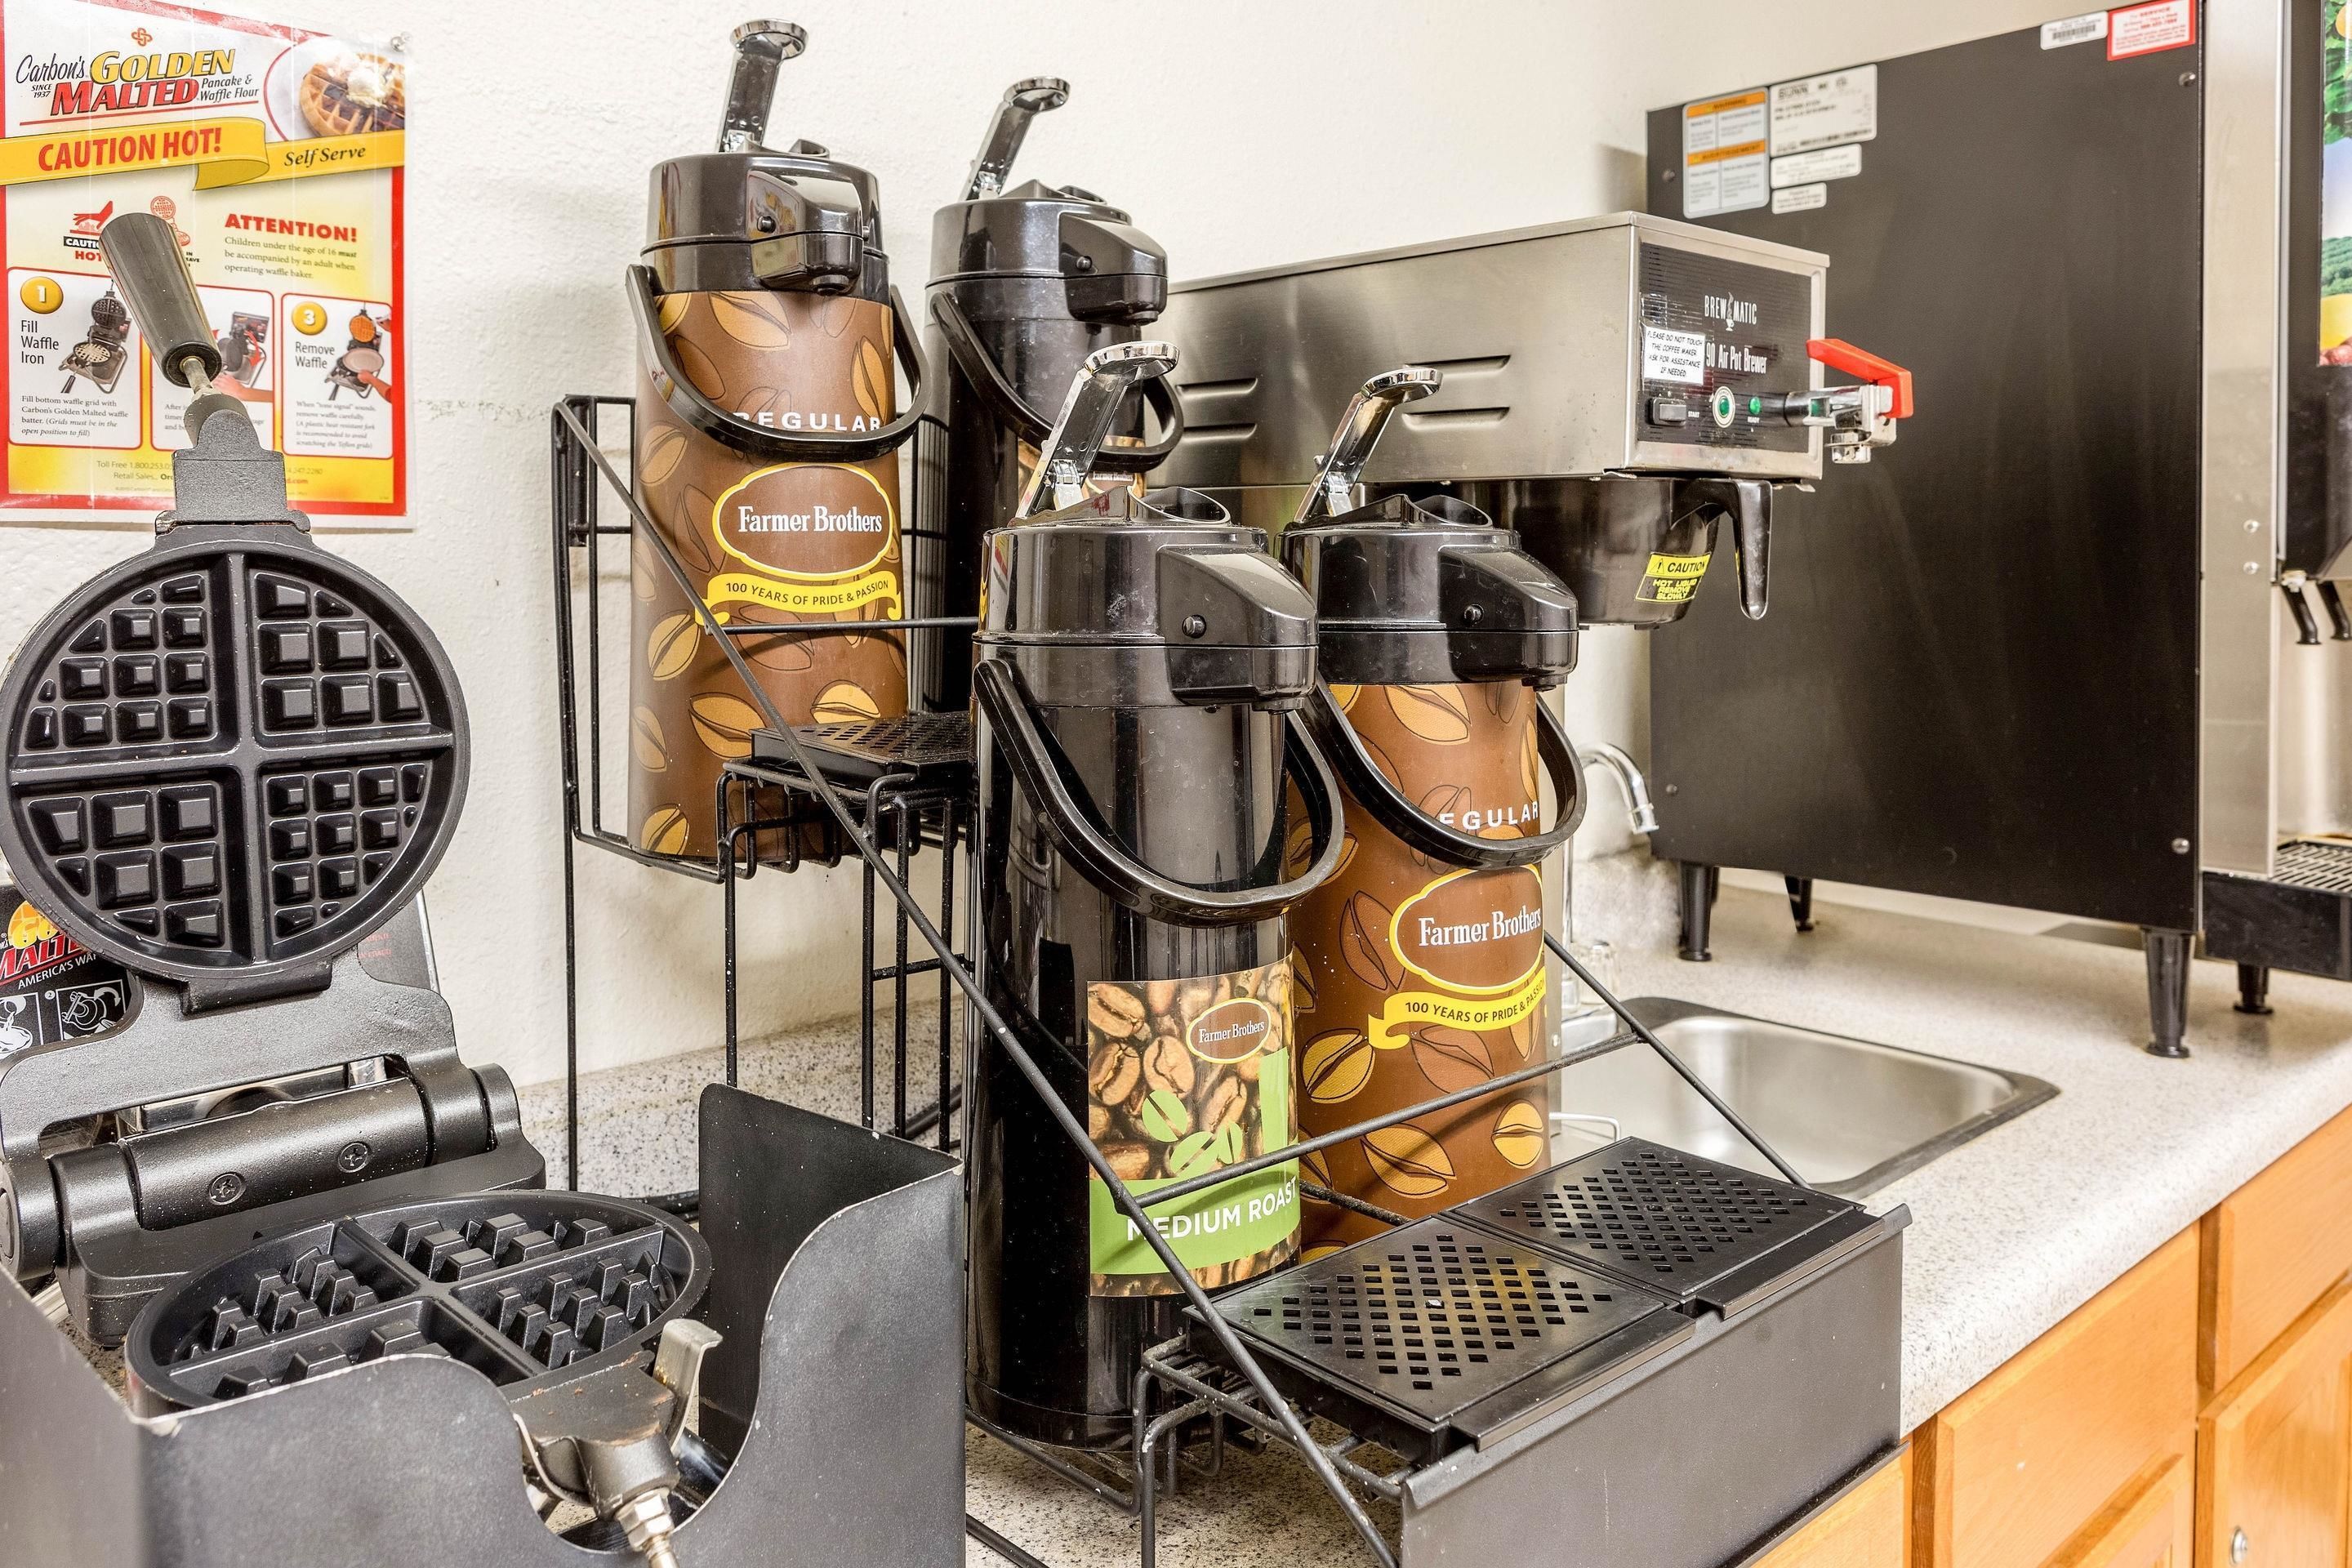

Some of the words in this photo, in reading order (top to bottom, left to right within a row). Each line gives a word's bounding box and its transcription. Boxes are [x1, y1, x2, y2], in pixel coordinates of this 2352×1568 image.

[16, 53, 85, 83] Carbon's
[90, 49, 235, 84] GOLDEN
[202, 76, 242, 88] Pancake
[245, 74, 252, 84] &
[50, 78, 199, 116] MALTED
[200, 88, 232, 103] Waffle
[234, 87, 259, 99] Flour
[38, 134, 156, 171] CAUTION
[163, 127, 222, 158] HOT!
[284, 148, 318, 168] Self
[319, 147, 366, 163] Serve
[225, 213, 357, 243] ATTENTION!
[65, 238, 99, 248] CAUTI
[225, 236, 261, 247] Children
[263, 242, 286, 250] under
[288, 243, 301, 252] the
[236, 252, 289, 264] accompanied
[291, 256, 301, 265] by
[314, 259, 333, 268] adult
[336, 262, 356, 271] when
[225, 264, 264, 276] operating
[265, 267, 288, 276] waffle
[37, 285, 47, 303] 1
[304, 310, 315, 326] 3
[21, 320, 38, 333] Fill
[21, 336, 59, 350] Waffle
[1647, 331, 1665, 340] PLEASE
[295, 341, 335, 355] Remove
[1663, 345, 1680, 354] COFFEE
[21, 351, 45, 364] Iron
[295, 356, 327, 368] Waffle
[1718, 344, 1729, 369] Air
[1730, 345, 1742, 371] Pot
[1744, 347, 1767, 374] Brewer
[35, 396, 61, 404] bottom
[85, 399, 100, 408] grid
[21, 406, 52, 414] Carbon's
[54, 408, 80, 416] Golden
[108, 410, 129, 418] waffle
[46, 417, 68, 425] (Grids
[40, 427, 68, 436] position
[78, 429, 91, 438] fill)
[737, 506, 810, 532] Farmer
[813, 506, 883, 532] Brothers
[1653, 579, 1673, 587] HOT
[726, 582, 747, 593] 100
[751, 585, 789, 603] YEARS
[792, 595, 808, 605] OF
[813, 595, 844, 605] PRIDE
[846, 594, 854, 602] &
[856, 579, 889, 599] PASSION
[1439, 800, 1539, 830] EGULAR
[1419, 917, 1490, 947] Farmer
[1491, 905, 1541, 939] Brothers
[18, 960, 74, 990] AMERICA'S
[1405, 1002, 1428, 1013] 100
[1433, 1004, 1470, 1022] YEARS
[1474, 1012, 1489, 1023] OF
[1492, 1004, 1518, 1022] PRIDE
[1519, 1001, 1526, 1012] &
[1199, 1028, 1232, 1043] Farmer
[1232, 1020, 1265, 1038] Brothers
[1249, 1175, 1297, 1223] ROAST
